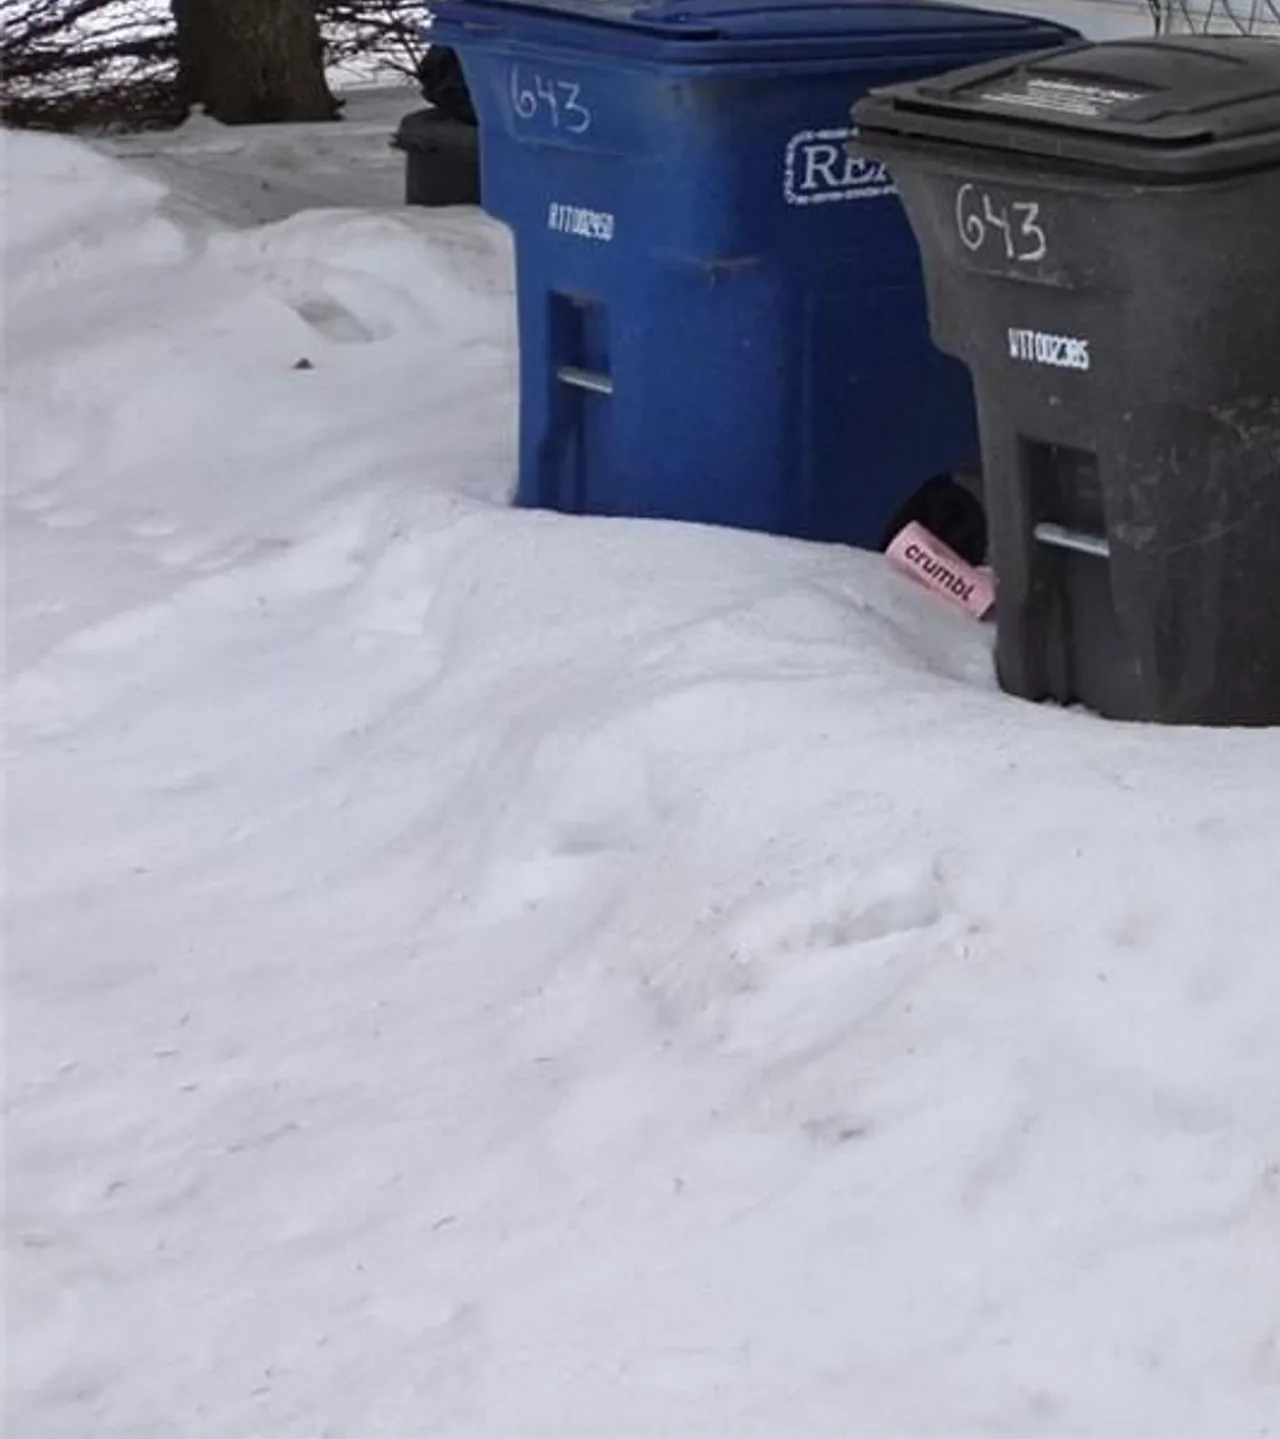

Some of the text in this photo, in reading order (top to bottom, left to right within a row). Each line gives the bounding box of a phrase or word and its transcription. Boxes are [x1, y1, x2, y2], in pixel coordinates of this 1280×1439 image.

[511, 63, 592, 134] 643
[956, 183, 1046, 261] 643
[904, 544, 976, 602] crumbl
